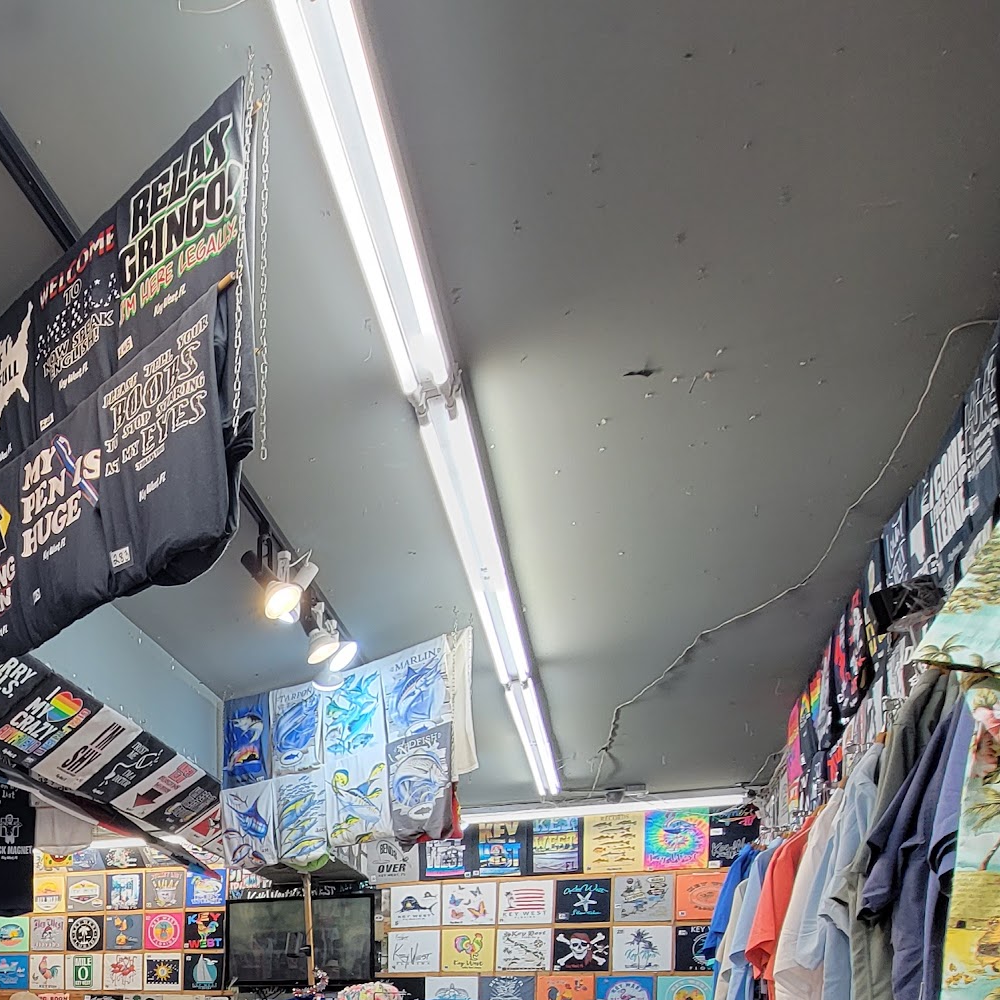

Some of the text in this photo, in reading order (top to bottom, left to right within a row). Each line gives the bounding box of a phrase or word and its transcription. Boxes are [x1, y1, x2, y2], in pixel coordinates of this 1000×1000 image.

[129, 113, 233, 240] RELAX
[119, 159, 243, 295] GRINGO!
[40, 224, 115, 310] WELCOME
[63, 279, 82, 306] TO
[139, 262, 173, 308] HERE
[71, 311, 114, 347] SPEAK
[101, 372, 138, 408] PLEASE
[177, 314, 208, 350] YOUR
[122, 411, 151, 439] STOP
[156, 371, 206, 417] STARING
[122, 440, 140, 464] MY
[140, 390, 208, 456] EYES
[22, 446, 56, 491] MY
[21, 449, 101, 524] PEN IS
[21, 491, 82, 558] HUGE
[394, 648, 437, 672] MARLIN
[45, 685, 61, 701] I
[278, 687, 312, 703] TARPON
[25, 696, 55, 718] MY
[10, 711, 58, 741] CRAZY
[61, 745, 102, 773] SHY
[2, 789, 15, 799] list
[479, 822, 519, 843] KEY
[7, 846, 33, 855] MAGNET
[378, 863, 407, 874] OVER
[565, 861, 577, 870] FL
[151, 916, 176, 927] KEY WEST
[187, 912, 222, 924] KEY
[152, 937, 176, 948] FLORIDA
[75, 957, 92, 965] MILE
